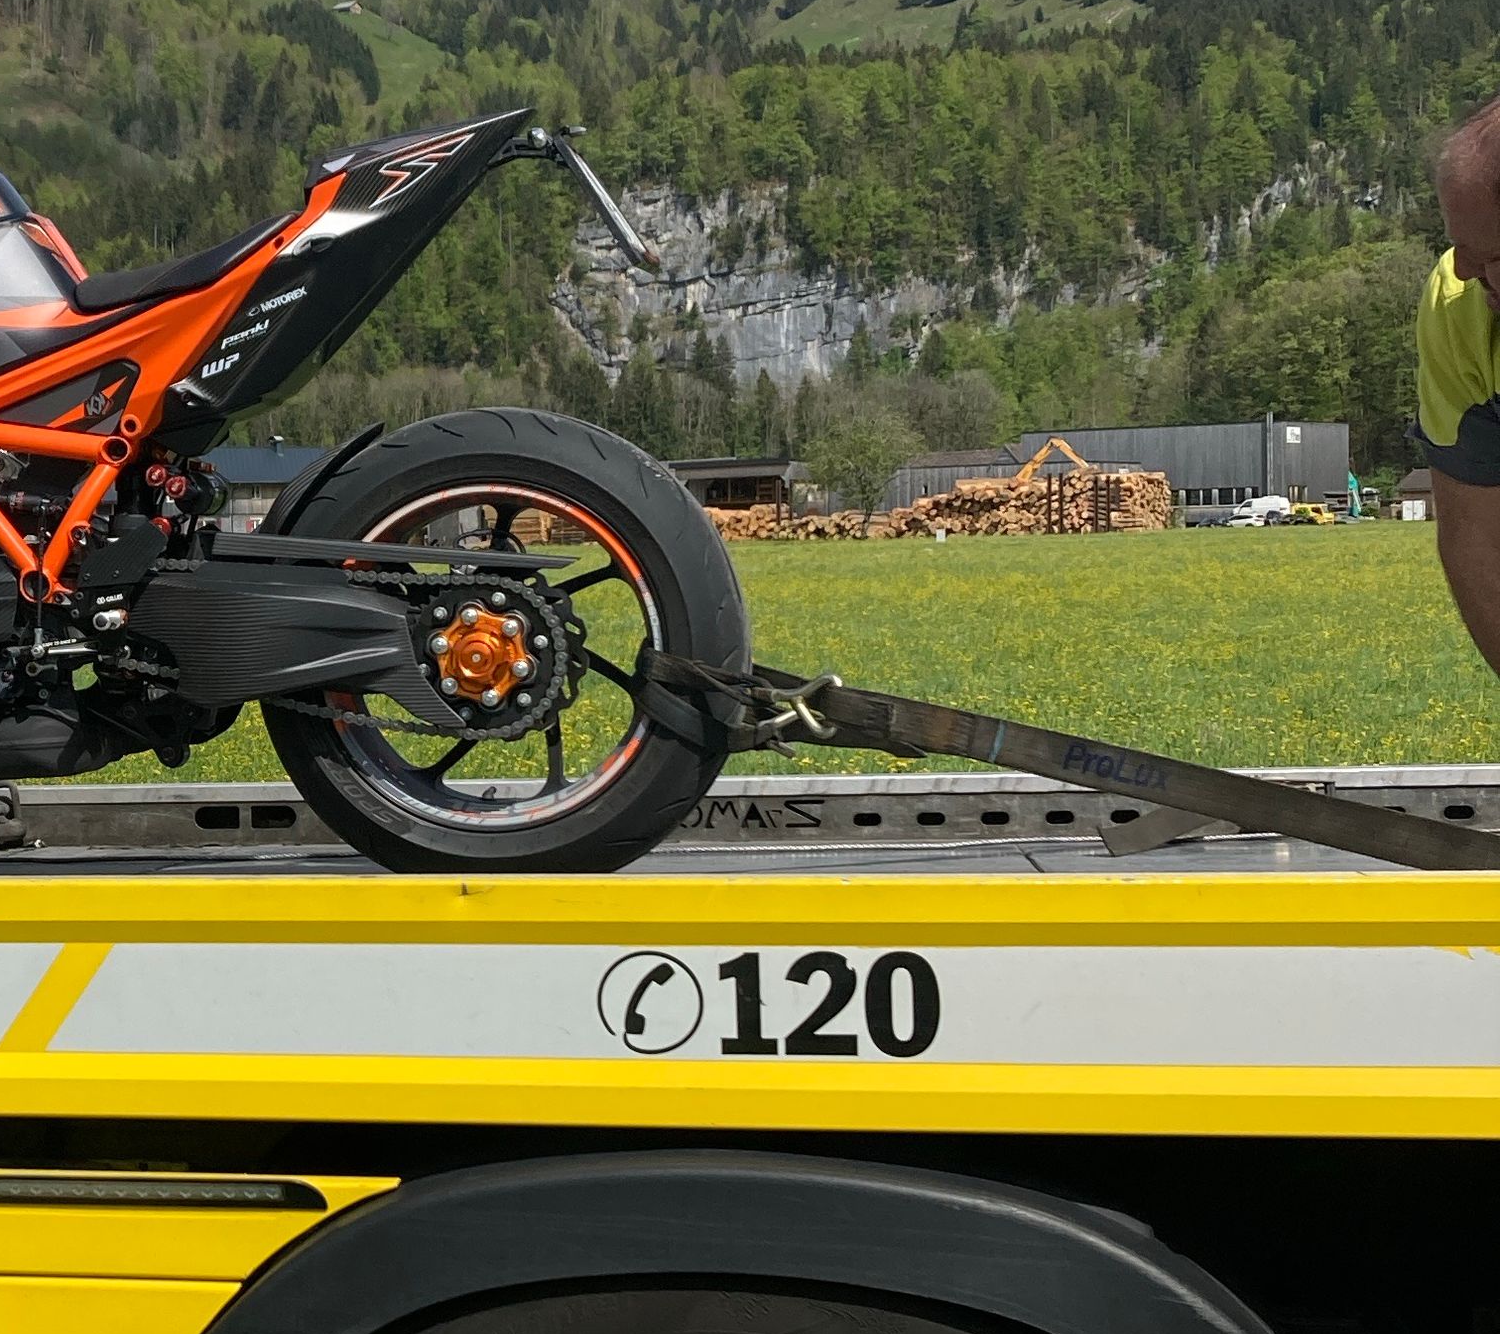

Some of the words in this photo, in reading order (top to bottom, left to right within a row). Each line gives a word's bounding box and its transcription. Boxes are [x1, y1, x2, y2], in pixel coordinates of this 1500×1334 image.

[260, 286, 307, 312] MOTOREX
[201, 352, 240, 379] WP
[718, 950, 941, 1058] 120
